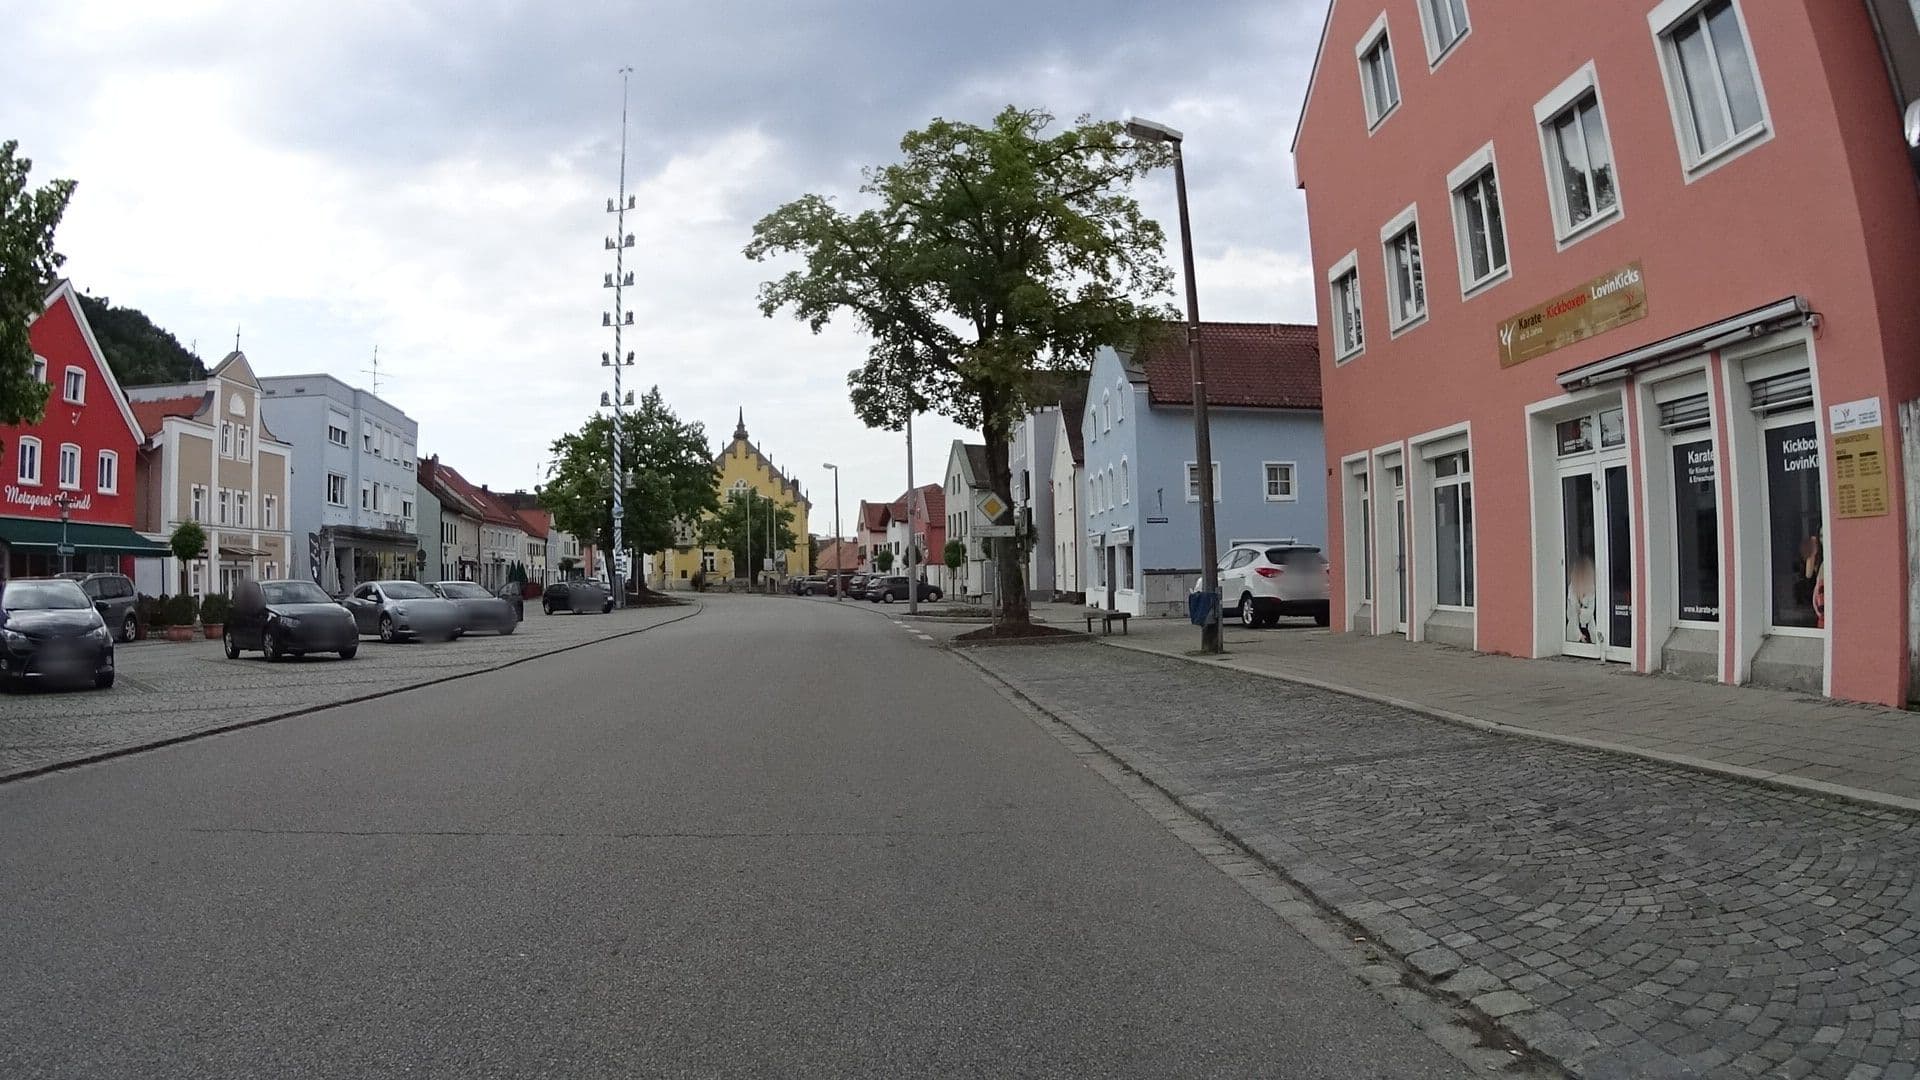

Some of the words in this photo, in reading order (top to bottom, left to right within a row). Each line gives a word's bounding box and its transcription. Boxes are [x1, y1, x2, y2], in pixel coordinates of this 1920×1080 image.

[1518, 313, 1542, 330] Karate
[1546, 293, 1586, 320] Kickboxen
[1591, 269, 1640, 300] LovinKicks
[1687, 449, 1714, 465] Karate
[4, 485, 53, 511] Metzgerei
